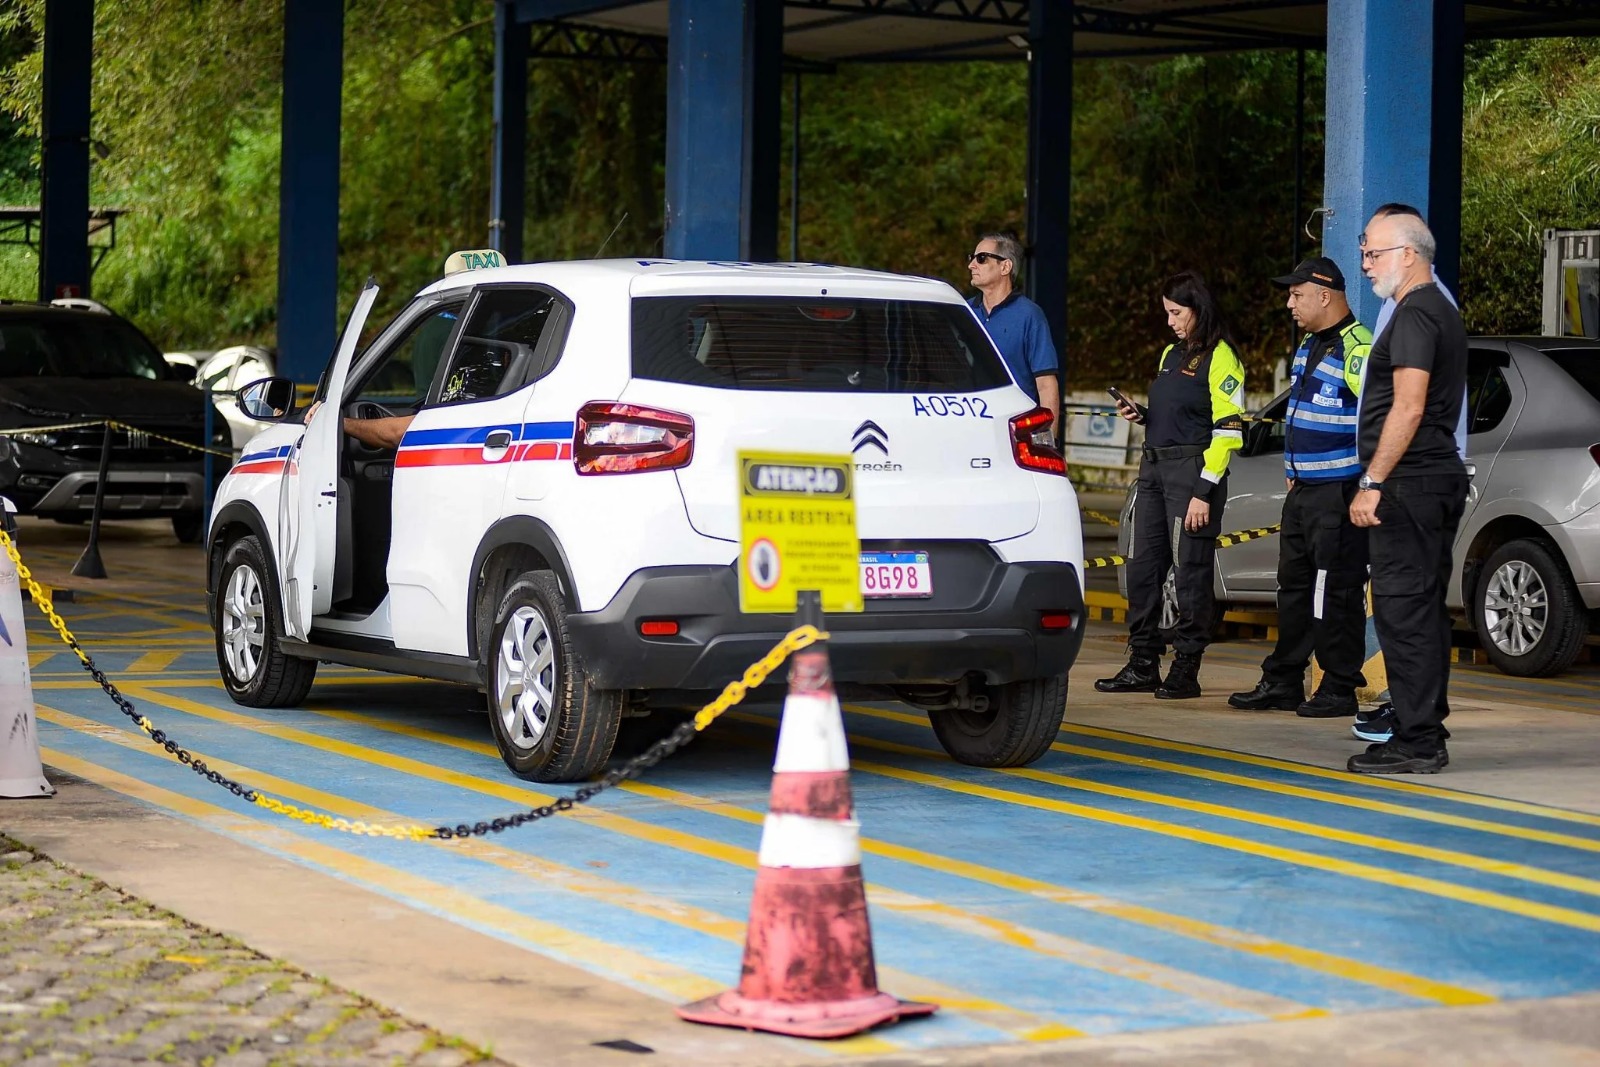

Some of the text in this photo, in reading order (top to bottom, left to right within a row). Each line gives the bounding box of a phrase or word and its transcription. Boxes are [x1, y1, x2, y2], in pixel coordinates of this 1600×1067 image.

[461, 252, 500, 269] TAXI
[913, 395, 993, 419] A-0512
[855, 461, 902, 472] TROËN
[970, 458, 991, 469] C3
[757, 465, 838, 495] ATENÇÃO
[790, 509, 854, 526] RESTRITA
[865, 566, 918, 589] 8G98
